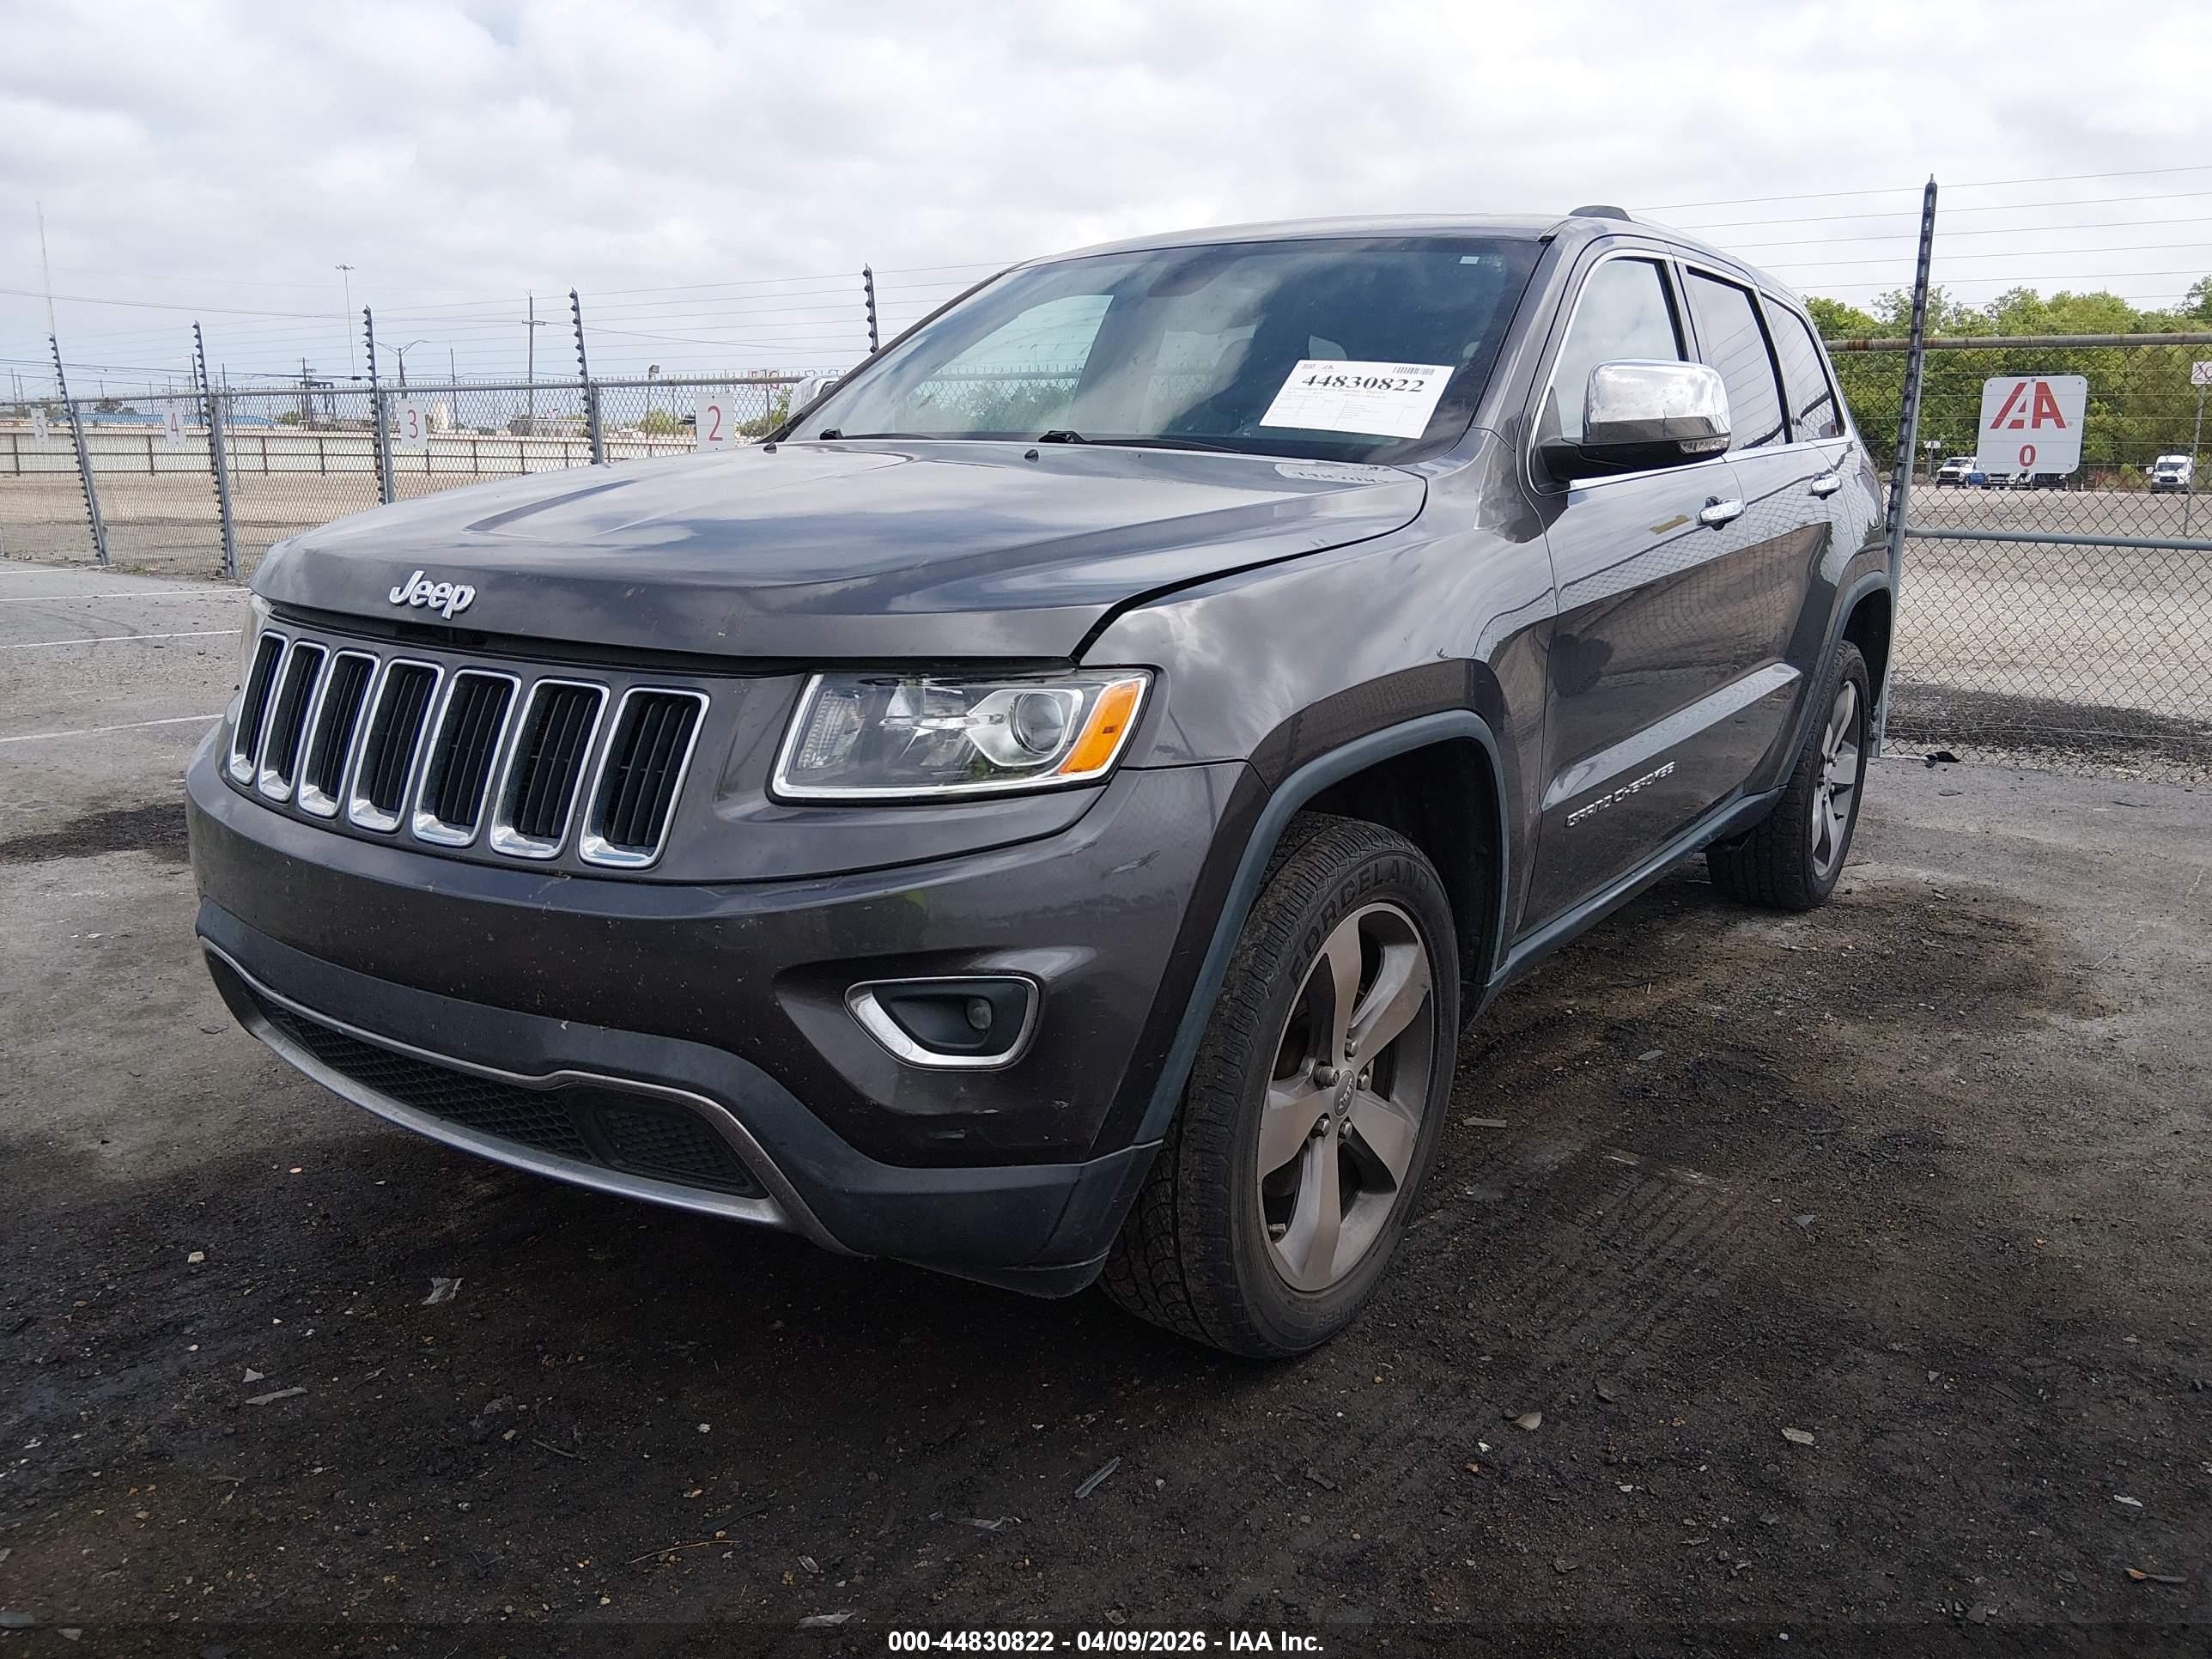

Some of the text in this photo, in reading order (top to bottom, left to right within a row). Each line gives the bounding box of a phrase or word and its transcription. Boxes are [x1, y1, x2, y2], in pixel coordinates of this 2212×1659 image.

[1301, 374, 1425, 392] 44830822
[35, 416, 44, 438] 5
[171, 412, 179, 438] 4
[408, 410, 418, 439] 3
[708, 405, 723, 441] 2
[2019, 444, 2036, 467] 0
[389, 570, 476, 619] Jeep
